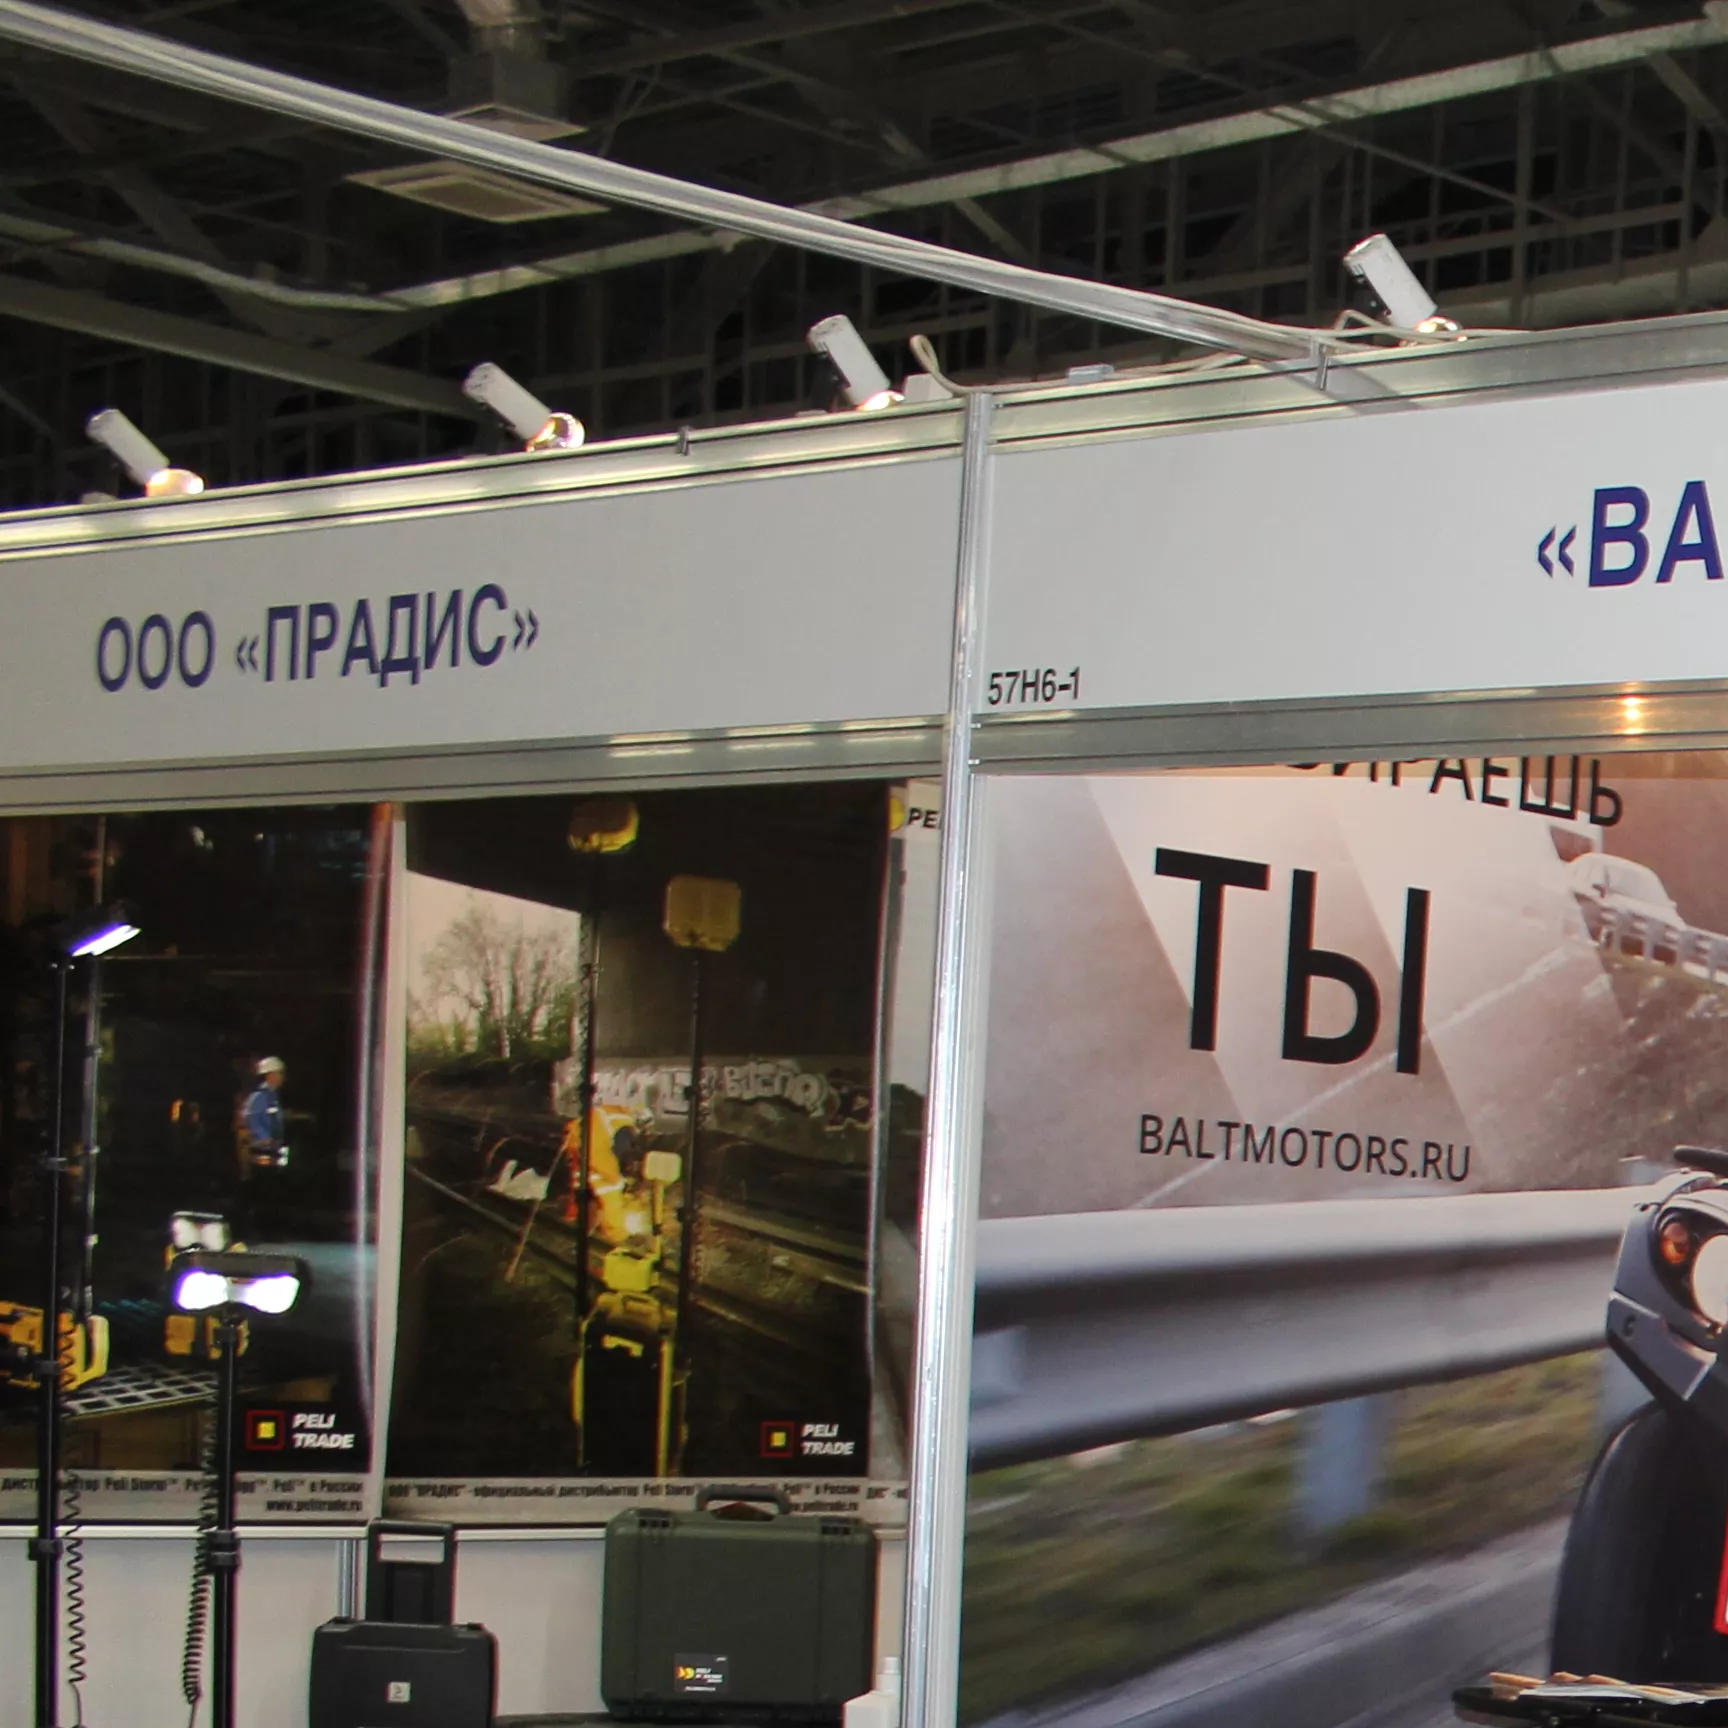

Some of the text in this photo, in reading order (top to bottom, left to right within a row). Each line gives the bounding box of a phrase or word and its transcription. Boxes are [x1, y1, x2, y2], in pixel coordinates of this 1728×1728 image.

[98, 583, 540, 692] ООО «ПРАДИС»
[987, 665, 1080, 705] 57H6-1
[907, 806, 942, 829] PE
[1154, 847, 1431, 1075] ТЫ
[1139, 1113, 1471, 1183] BALTMOTORS.RU
[292, 1413, 336, 1429] PELI
[803, 1424, 839, 1438] PELI
[294, 1433, 355, 1450] TRADE
[803, 1441, 855, 1456] TRADE
